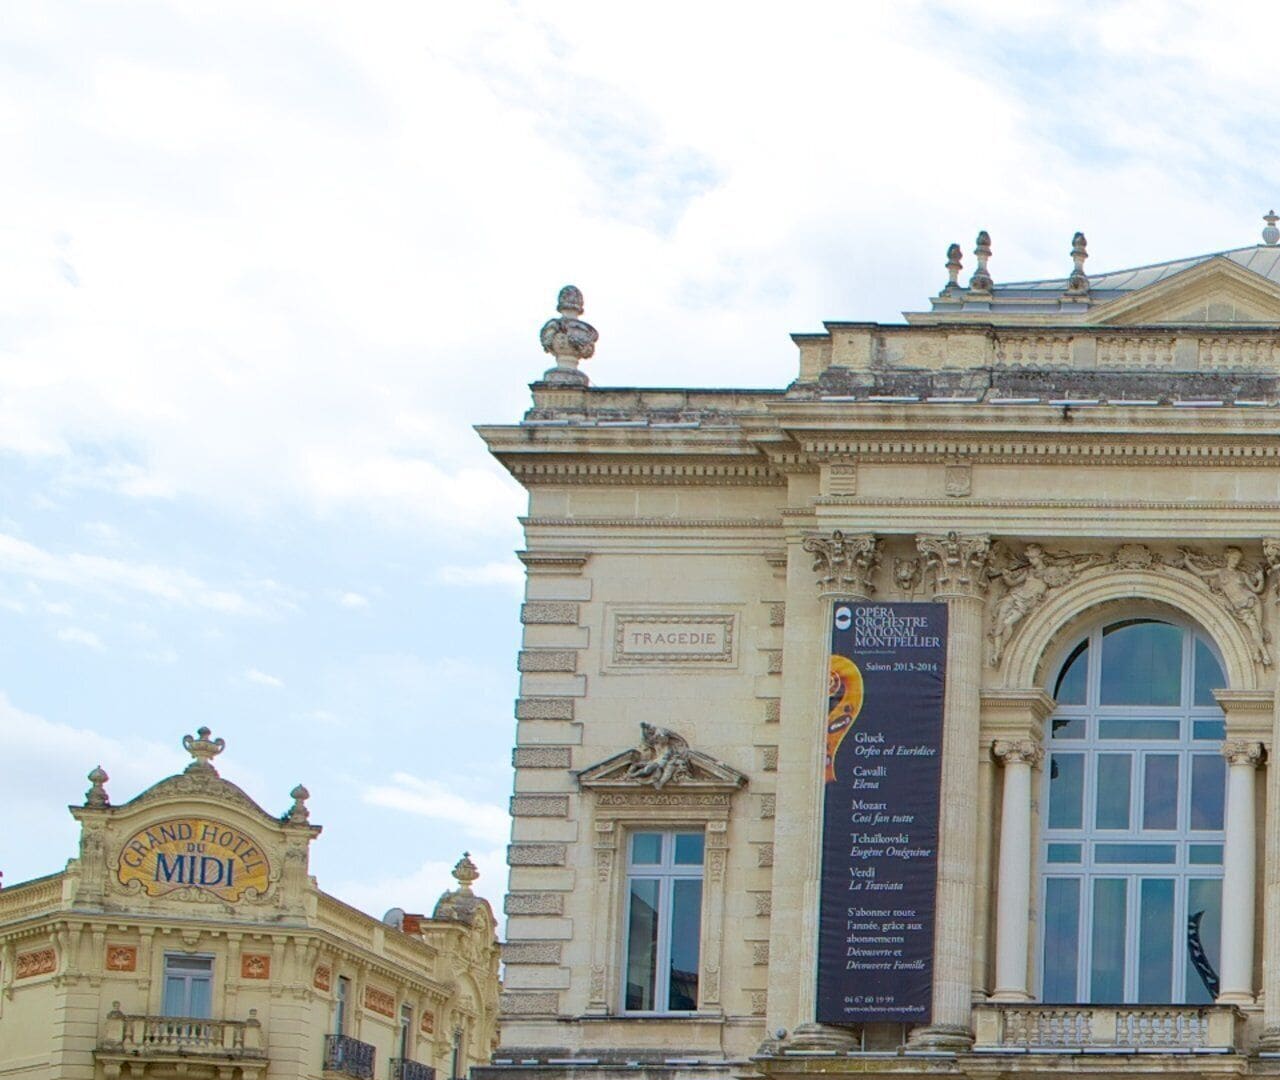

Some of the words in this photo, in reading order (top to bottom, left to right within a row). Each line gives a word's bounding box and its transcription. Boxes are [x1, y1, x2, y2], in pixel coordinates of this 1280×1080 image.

[855, 616, 929, 628] ORCHESTRE
[855, 626, 918, 637] NATIONAL
[632, 632, 716, 644] TRAGEDIE
[854, 636, 941, 648] MONTPELLIER
[865, 662, 892, 671] Saison
[854, 732, 885, 744] Gluck
[854, 745, 881, 758] Orfeo
[883, 745, 895, 756] ed
[896, 745, 936, 756] Euridice
[853, 766, 887, 777] Cavalli
[852, 778, 879, 789] Elena
[852, 800, 887, 810] Mozart
[871, 812, 890, 825] fan
[892, 814, 914, 823] tutte
[850, 833, 909, 844] Tchaïkovski
[123, 823, 192, 868] GRAND
[201, 825, 264, 873] HOTEL
[186, 843, 205, 853] DU
[850, 846, 883, 859] Eugène
[886, 846, 931, 859] Onéguine
[154, 853, 235, 887] MIDI
[849, 867, 876, 877] Verdi
[849, 880, 862, 890] La
[865, 880, 903, 890] Traviata
[848, 908, 890, 917] S'abonner
[893, 909, 916, 917] toute
[882, 921, 905, 932] grâce
[907, 922, 922, 930] aux
[846, 934, 905, 943] abonnements
[846, 947, 891, 957] Découverte
[846, 960, 891, 970] Découverte
[893, 960, 925, 970] Famille
